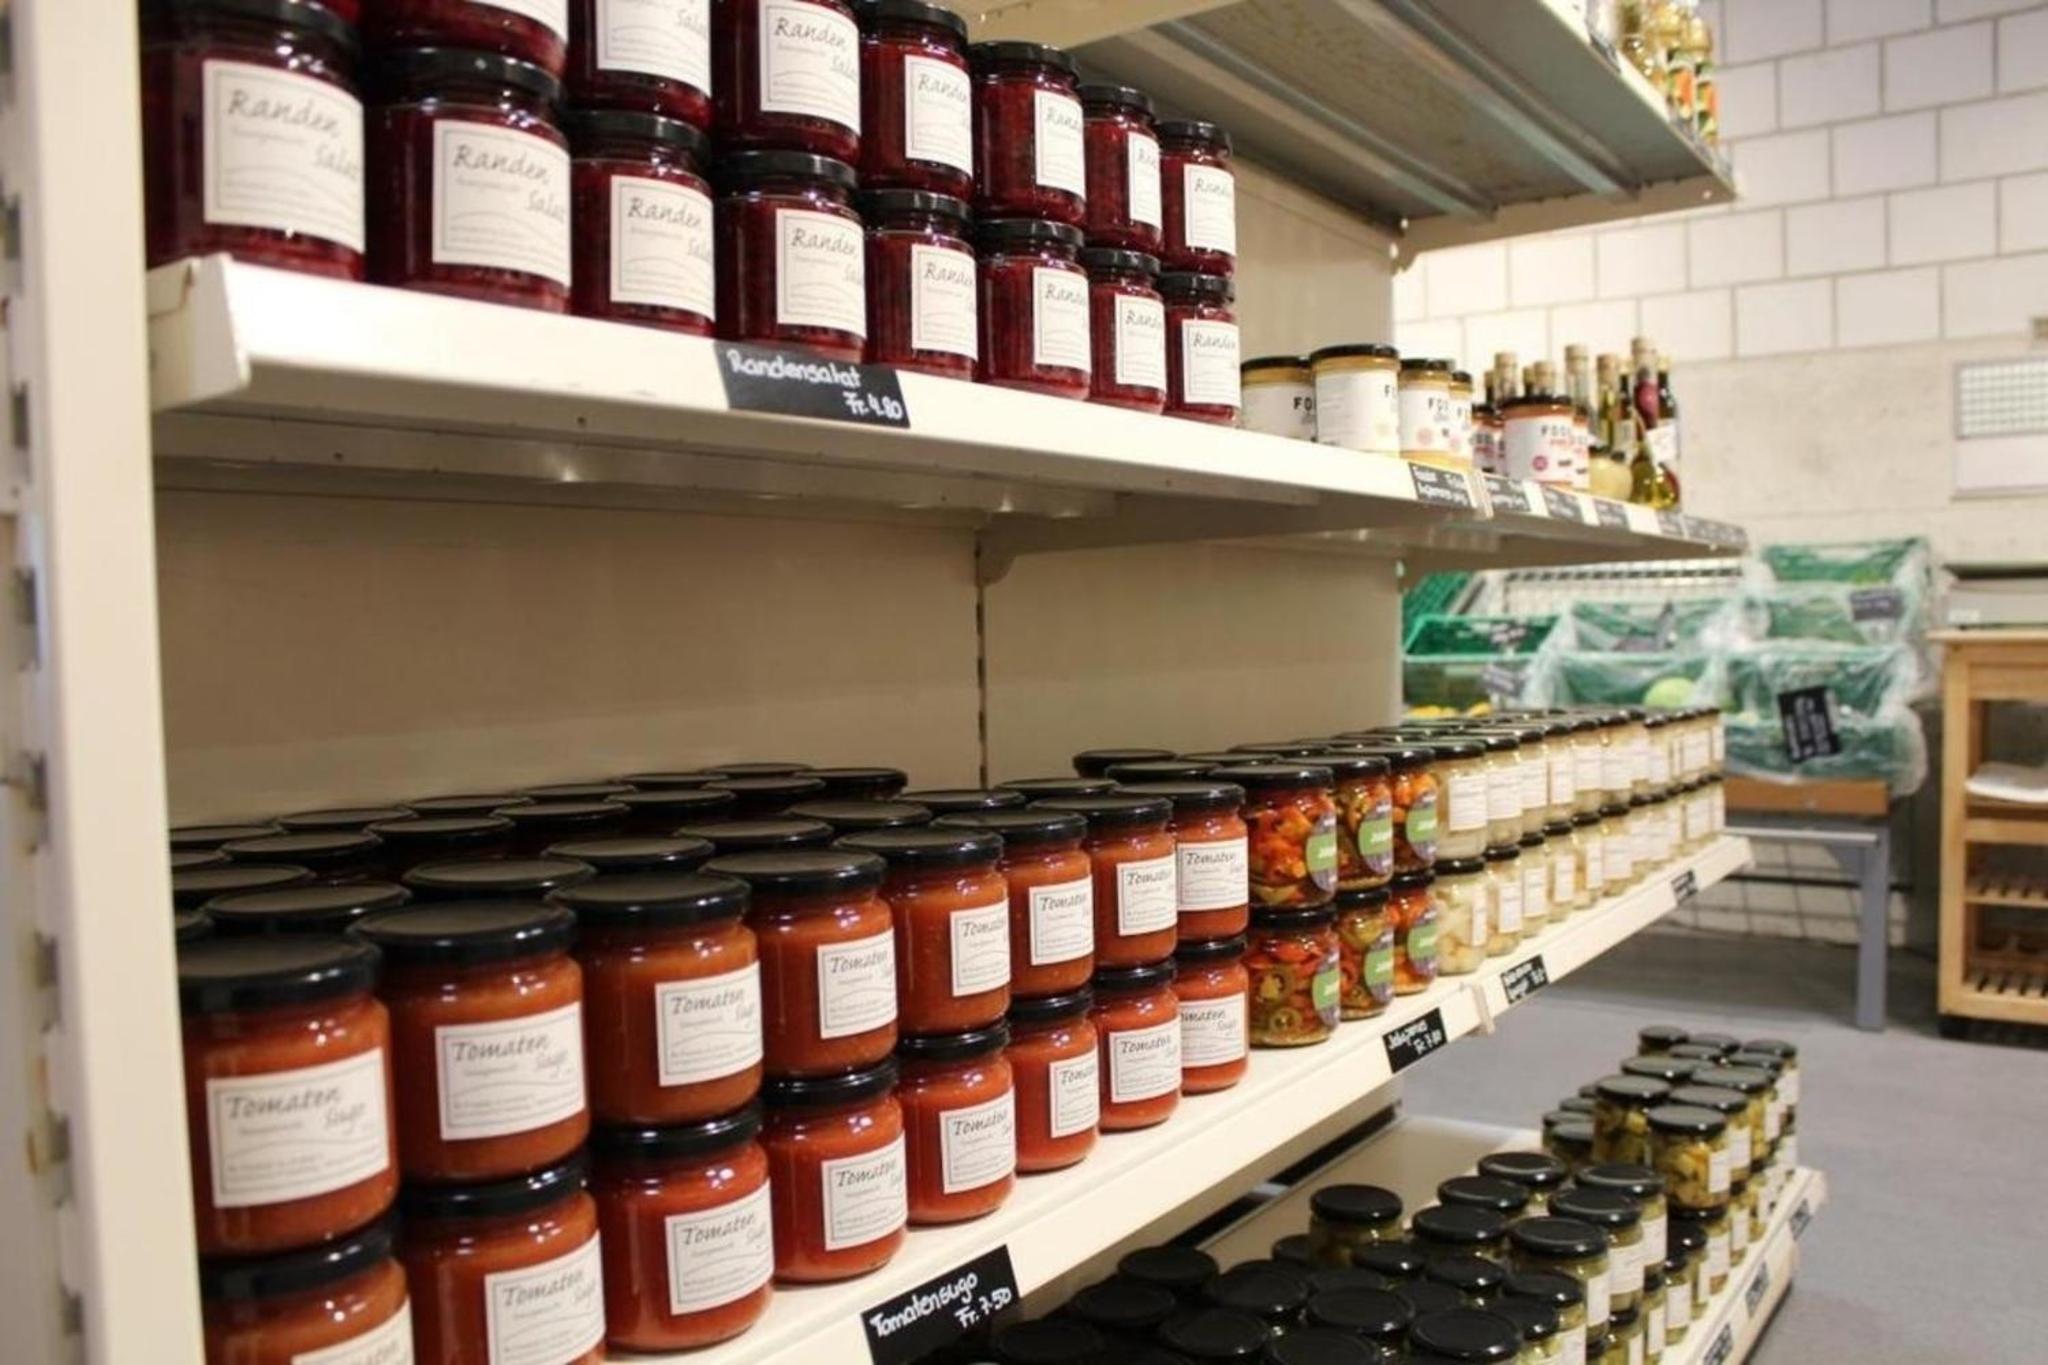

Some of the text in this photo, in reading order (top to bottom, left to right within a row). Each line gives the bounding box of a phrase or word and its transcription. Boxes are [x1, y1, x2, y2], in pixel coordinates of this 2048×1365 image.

[774, 17, 846, 51] Randen
[228, 89, 341, 137] Randen
[452, 144, 551, 185] Randen
[725, 349, 861, 389] Randensalat
[670, 988, 744, 1017] Tomaten
[449, 1033, 551, 1063] Tomaten
[225, 1086, 341, 1121] Tomaten
[682, 1212, 756, 1247] Tomaten
[502, 1267, 586, 1308] Tomaten
[869, 1272, 979, 1338] Tomatensugo
[954, 1305, 980, 1329] Fr.
